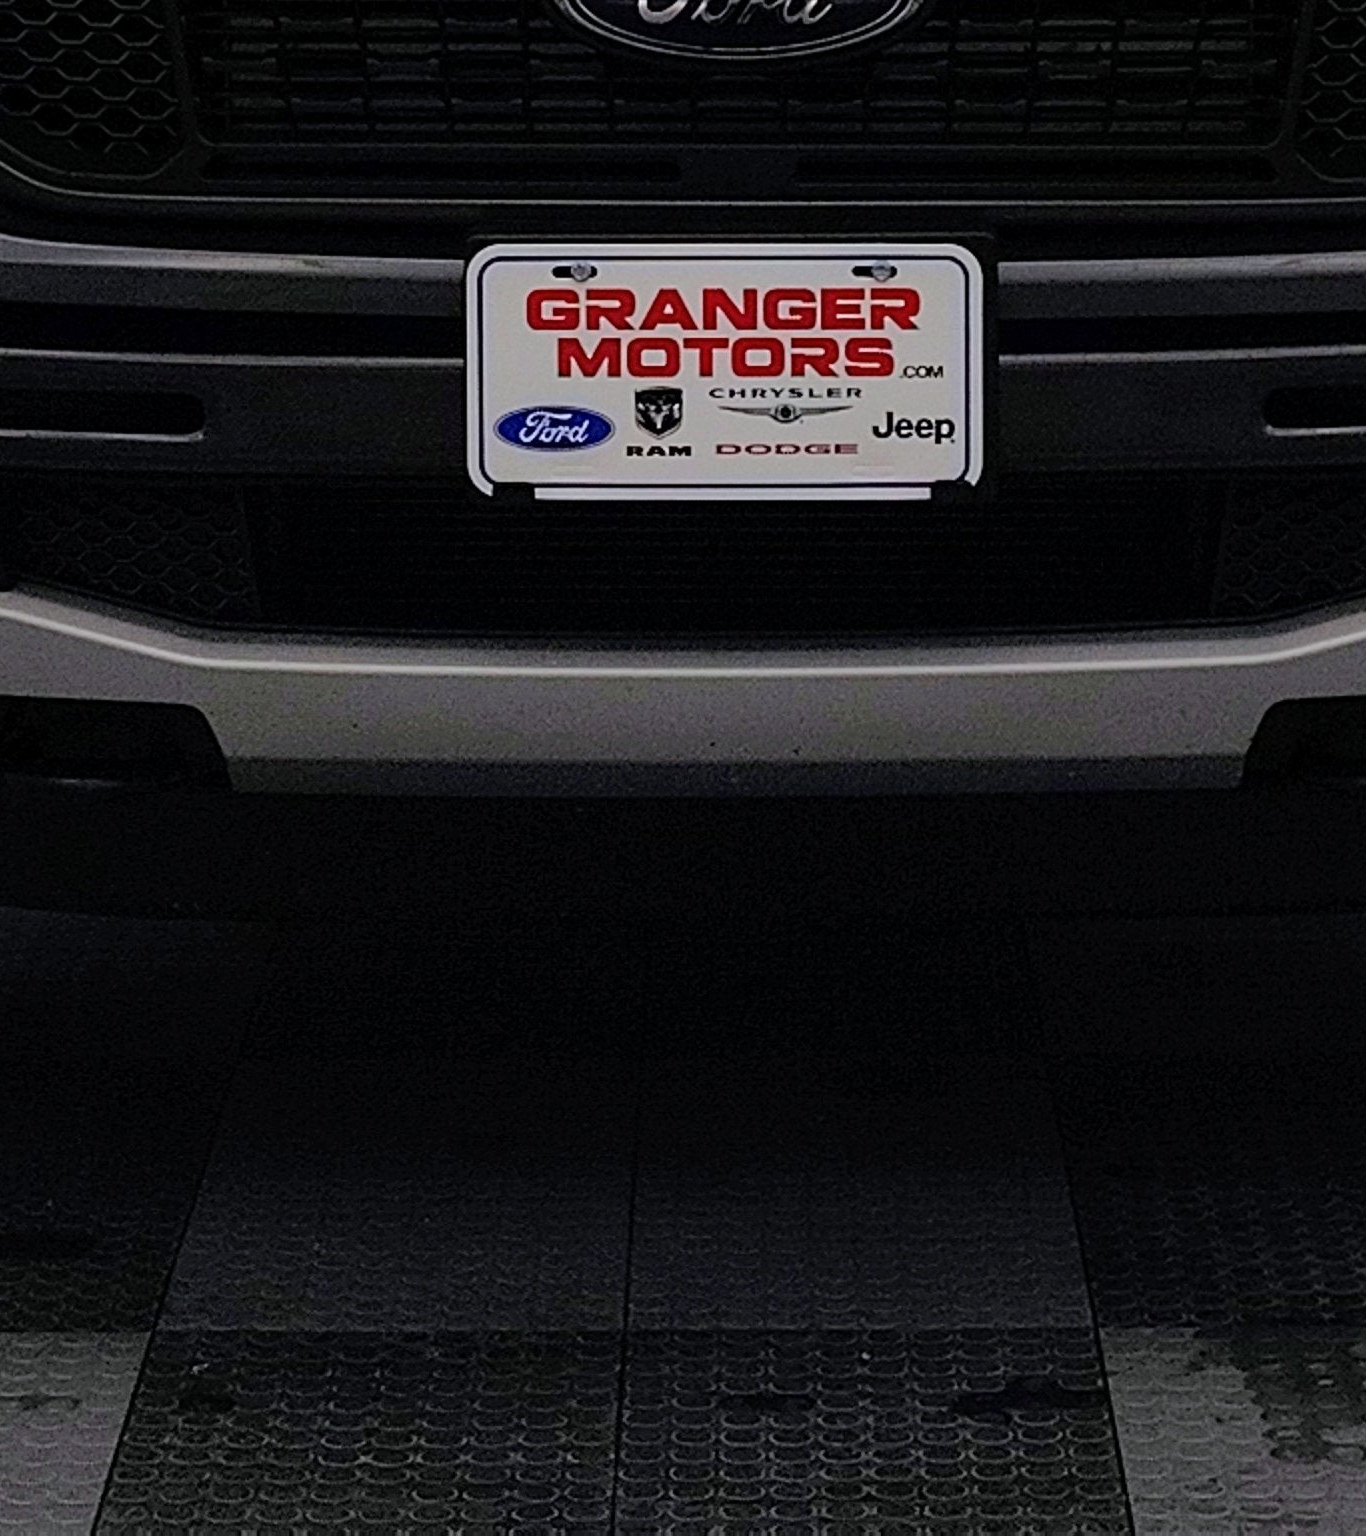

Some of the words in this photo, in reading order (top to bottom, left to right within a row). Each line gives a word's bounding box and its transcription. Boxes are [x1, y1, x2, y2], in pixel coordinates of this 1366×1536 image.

[525, 288, 922, 331] GRANGER
[557, 337, 896, 378] MOTORS
[709, 387, 863, 399] CHRYSLER
[518, 410, 590, 444] Ford
[872, 411, 955, 445] Jeep
[626, 445, 692, 458] RAM
[715, 443, 860, 456] DODGE
